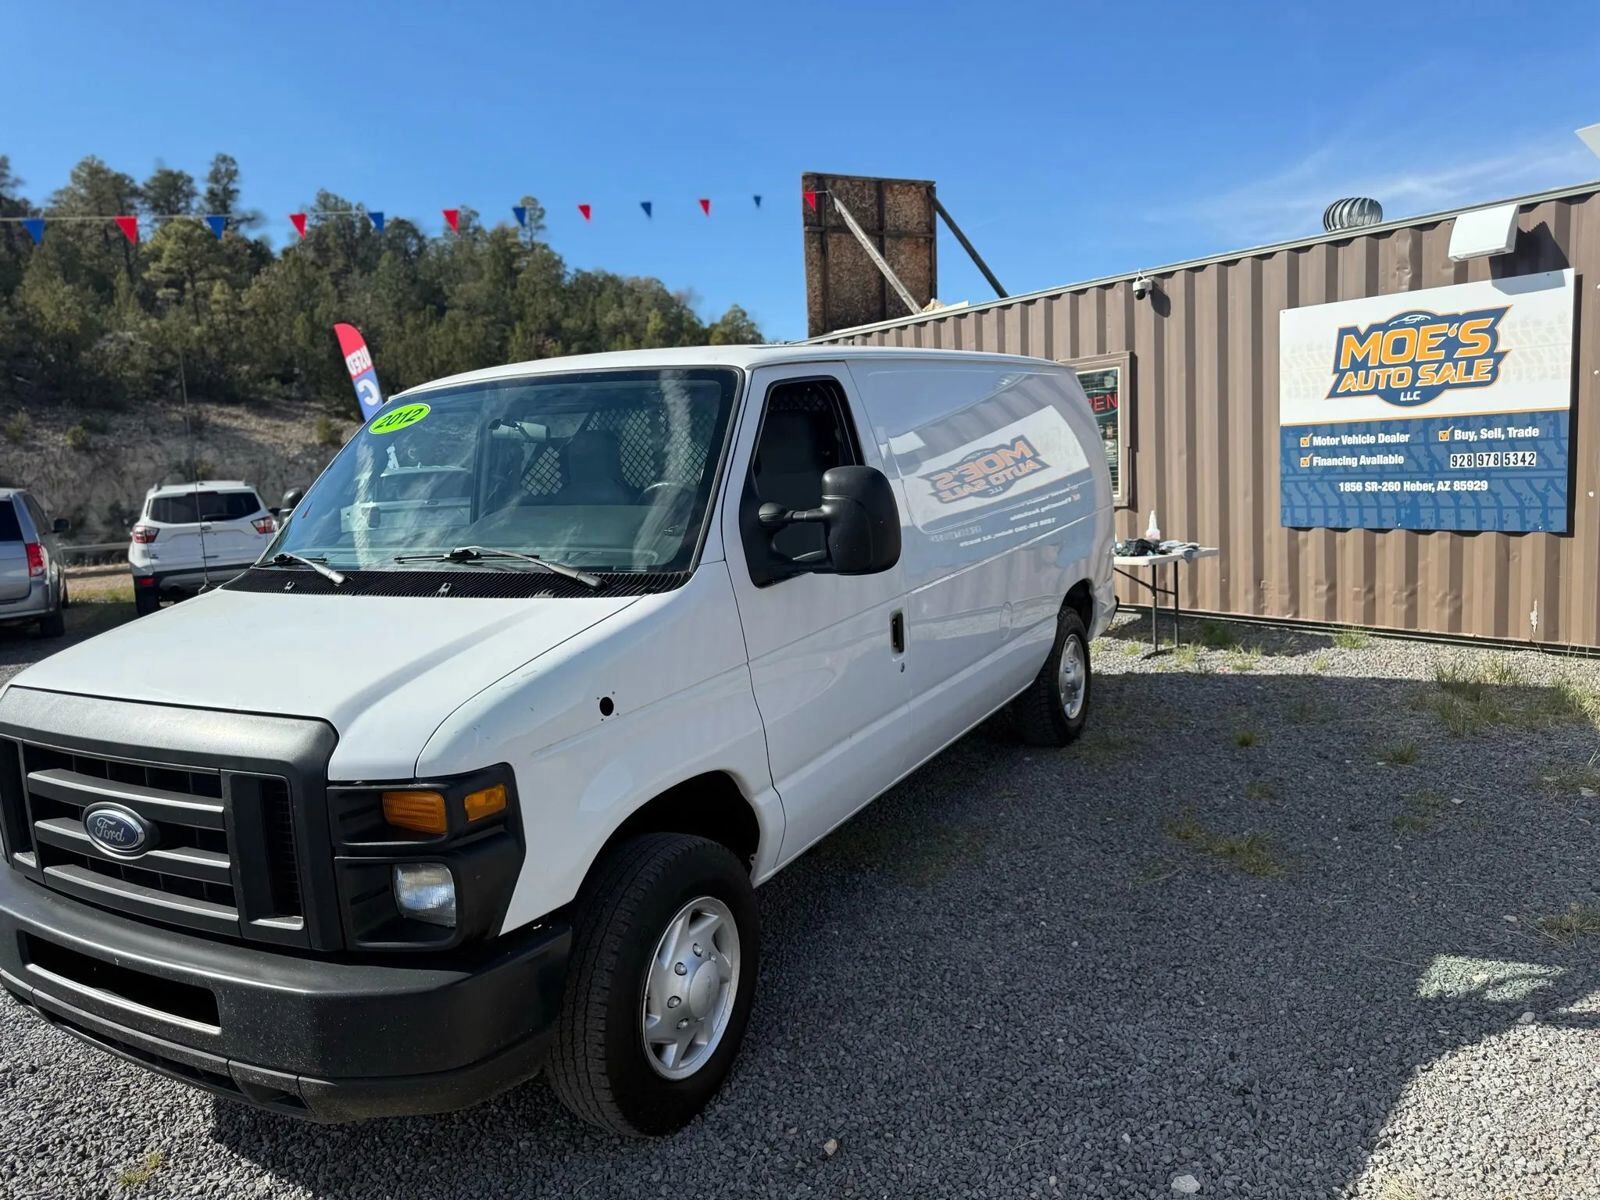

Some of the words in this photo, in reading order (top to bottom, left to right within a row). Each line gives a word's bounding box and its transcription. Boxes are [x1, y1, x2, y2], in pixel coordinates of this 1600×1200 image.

[1339, 317, 1495, 370] MOE'S
[1336, 366, 1412, 393] AUTO
[1415, 358, 1494, 387] SALE
[1400, 390, 1421, 402] LLC
[373, 408, 425, 430] 2012
[1312, 435, 1340, 446] Motor
[1341, 433, 1376, 445] Vehicle
[1378, 432, 1411, 443] Dealer
[1454, 429, 1478, 441] Buy,
[1480, 427, 1505, 440] Sell,
[1507, 426, 1540, 438] Trade
[1312, 455, 1358, 467] Financing
[1359, 453, 1404, 465] Available
[1451, 454, 1473, 467] 928
[1477, 453, 1499, 466] 978
[1504, 452, 1536, 466] 5342
[1339, 481, 1362, 492] 1856
[1364, 481, 1401, 492] SR-260
[1403, 480, 1435, 493] Heber,
[1436, 480, 1451, 491] AZ
[1453, 480, 1489, 491] 85929
[94, 816, 126, 842] Ford
